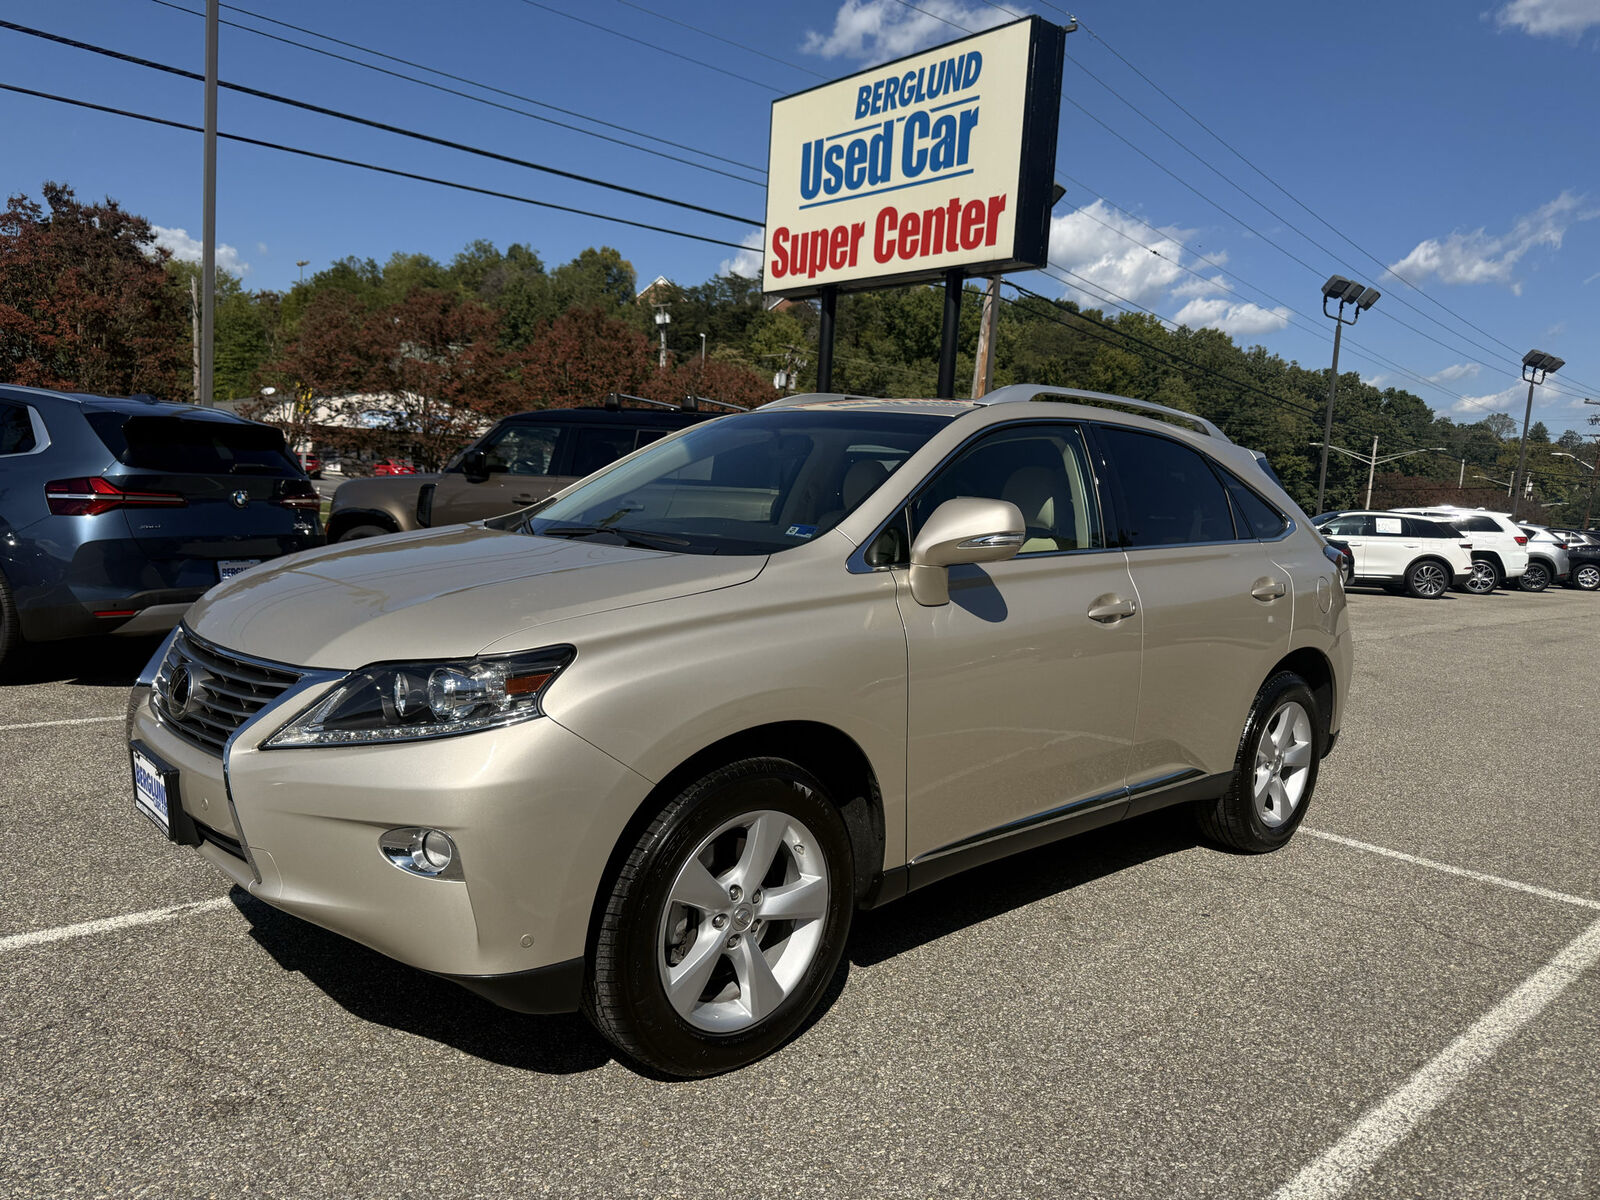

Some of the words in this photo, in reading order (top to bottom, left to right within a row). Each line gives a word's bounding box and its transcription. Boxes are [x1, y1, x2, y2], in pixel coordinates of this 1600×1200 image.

[854, 50, 983, 120] BERGLUND
[799, 118, 894, 201] Used
[901, 106, 980, 179] Car
[771, 221, 866, 279] Super
[873, 193, 1007, 265] Center
